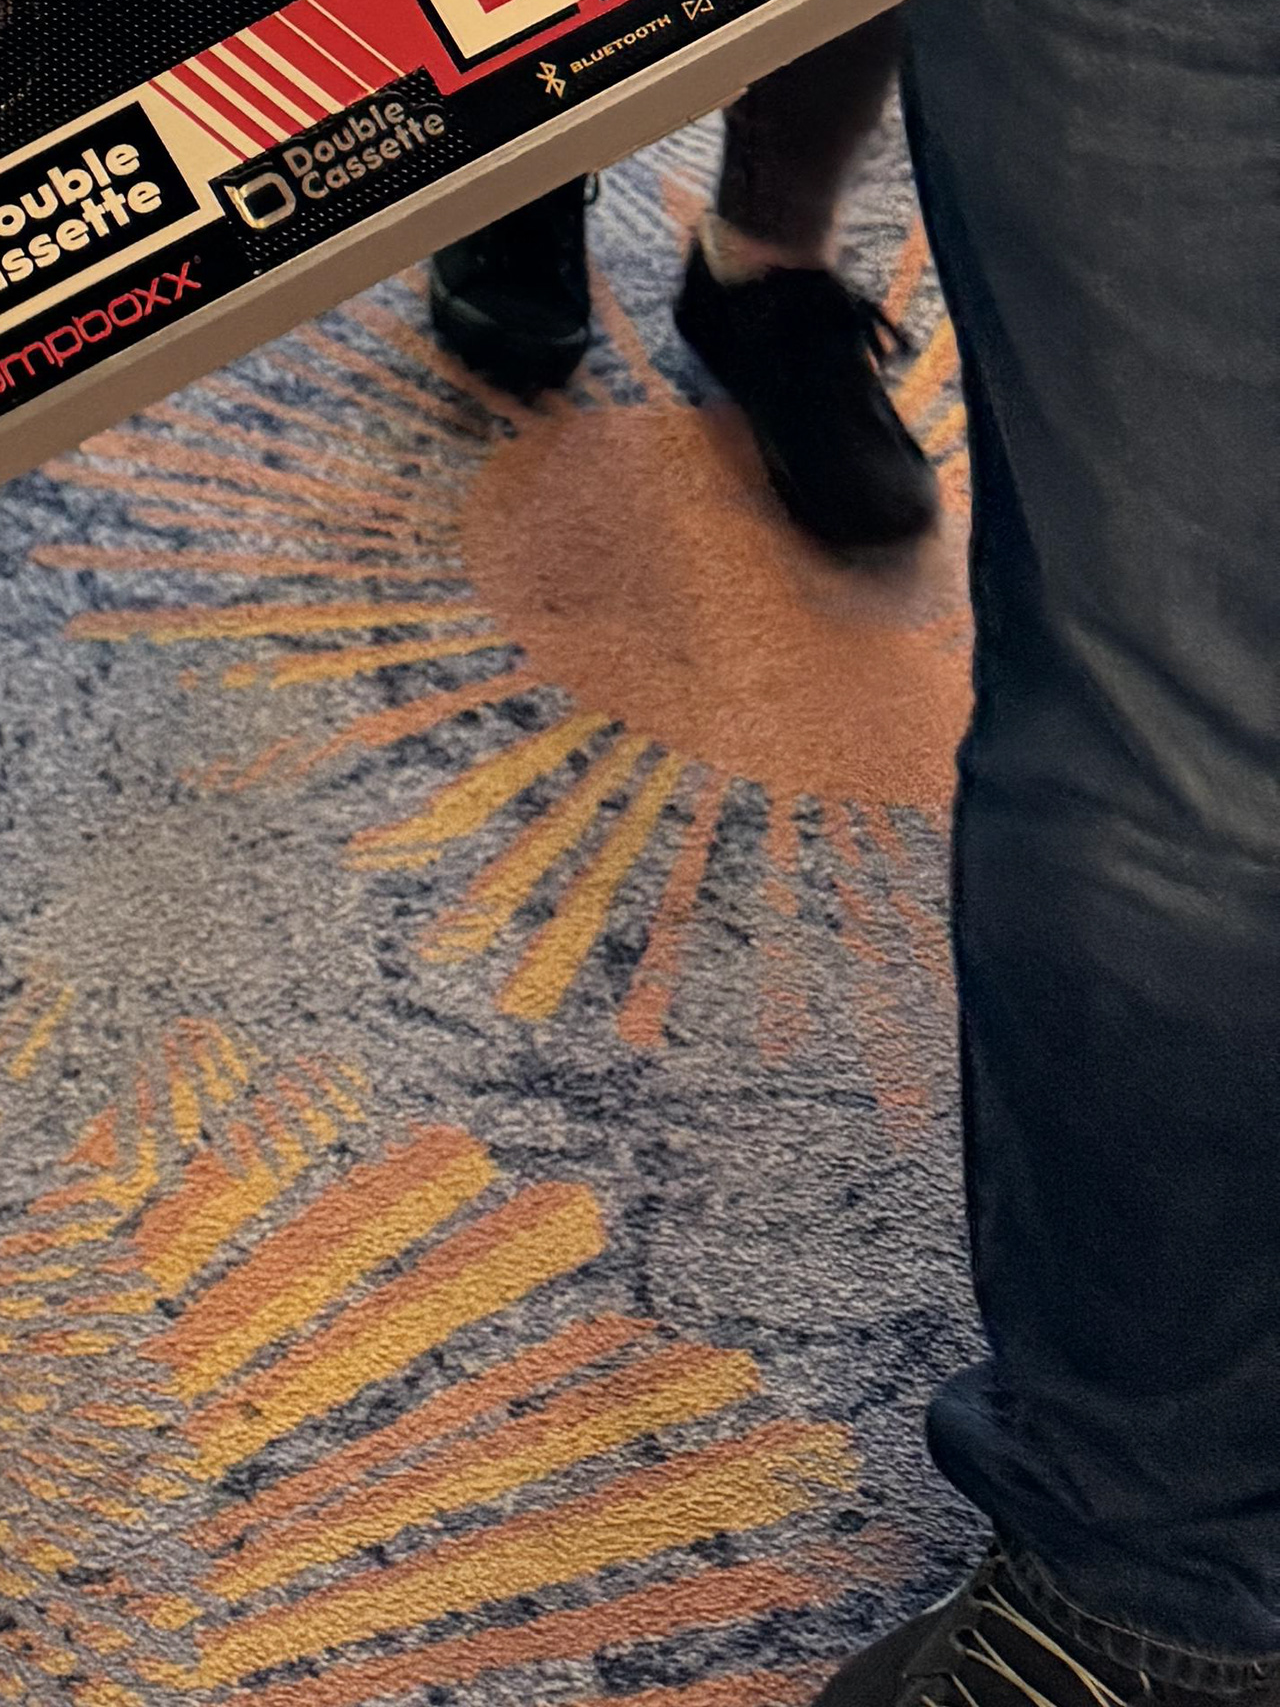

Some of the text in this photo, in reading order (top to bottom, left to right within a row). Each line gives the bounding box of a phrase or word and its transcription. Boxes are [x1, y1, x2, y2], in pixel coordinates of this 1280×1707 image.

[569, 12, 673, 76] BLUETOOTH
[283, 94, 410, 182] Double
[298, 105, 449, 205] Cassette
